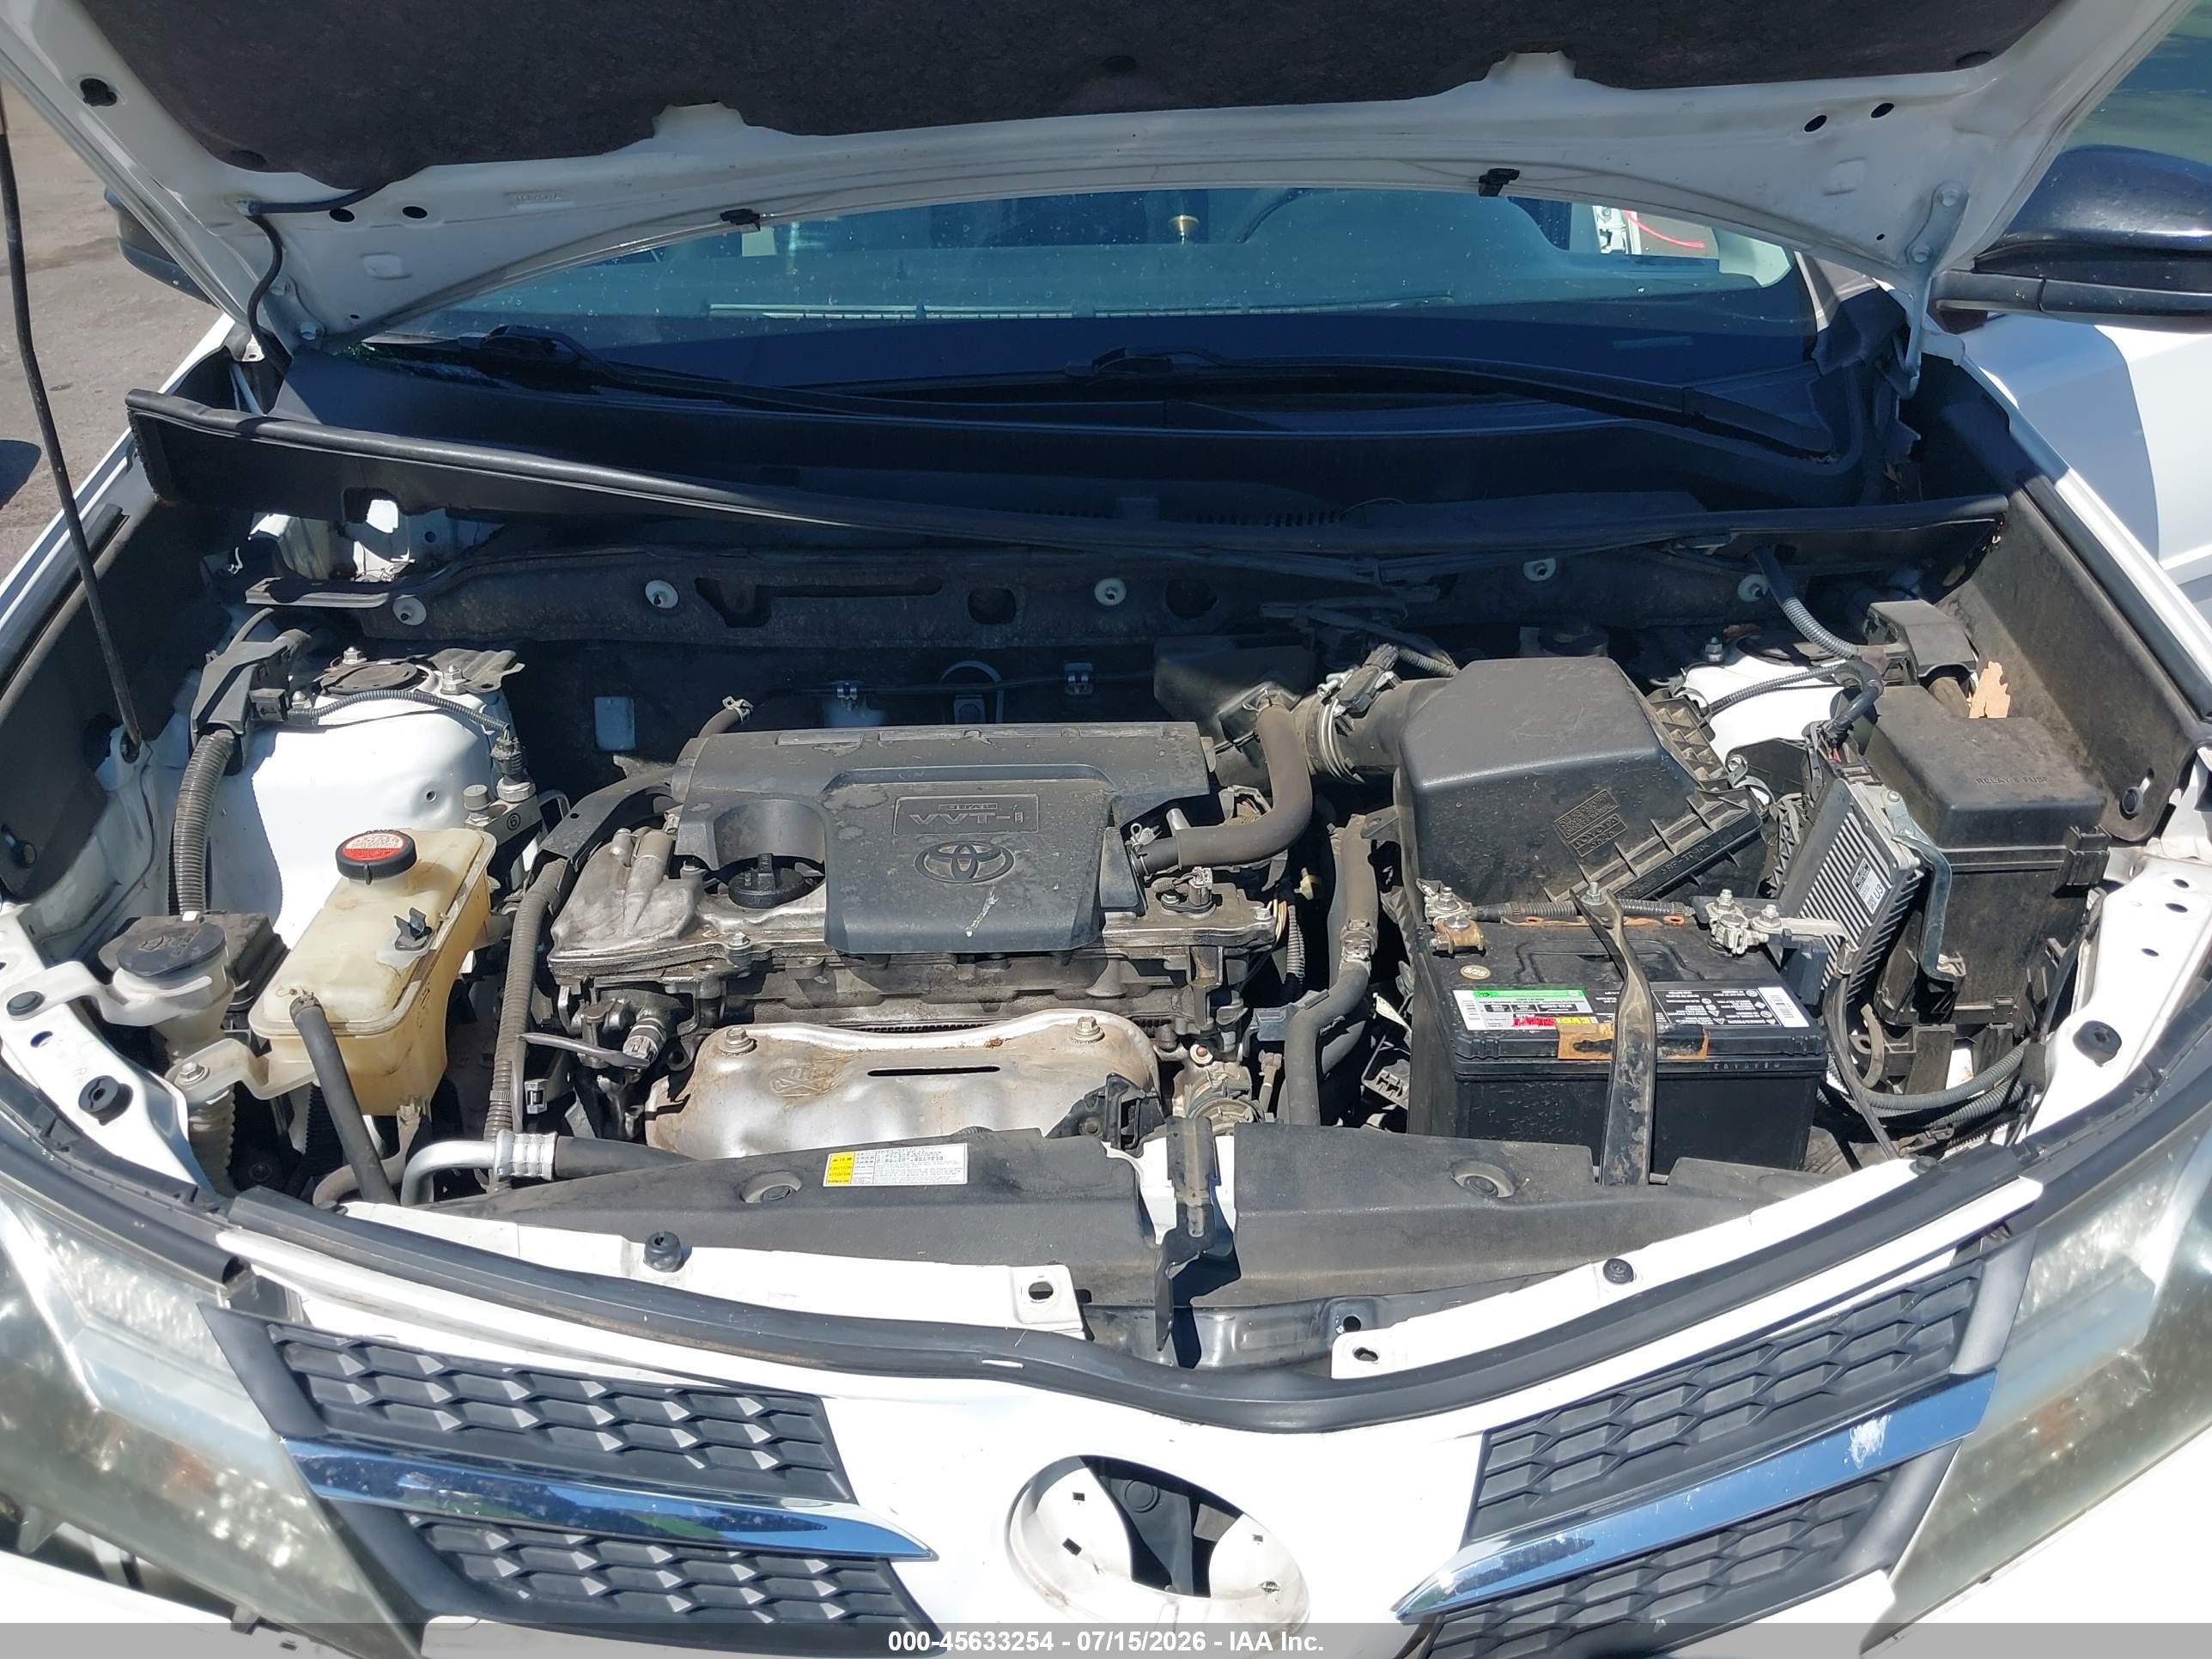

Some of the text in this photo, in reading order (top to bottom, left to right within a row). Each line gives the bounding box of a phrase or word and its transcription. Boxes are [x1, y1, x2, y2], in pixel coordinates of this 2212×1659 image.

[1975, 775, 2009, 784] RELAY
[2022, 775, 2050, 784] FUSE
[1573, 815, 1620, 846] TOYOTA
[1873, 884, 1884, 900] U3
